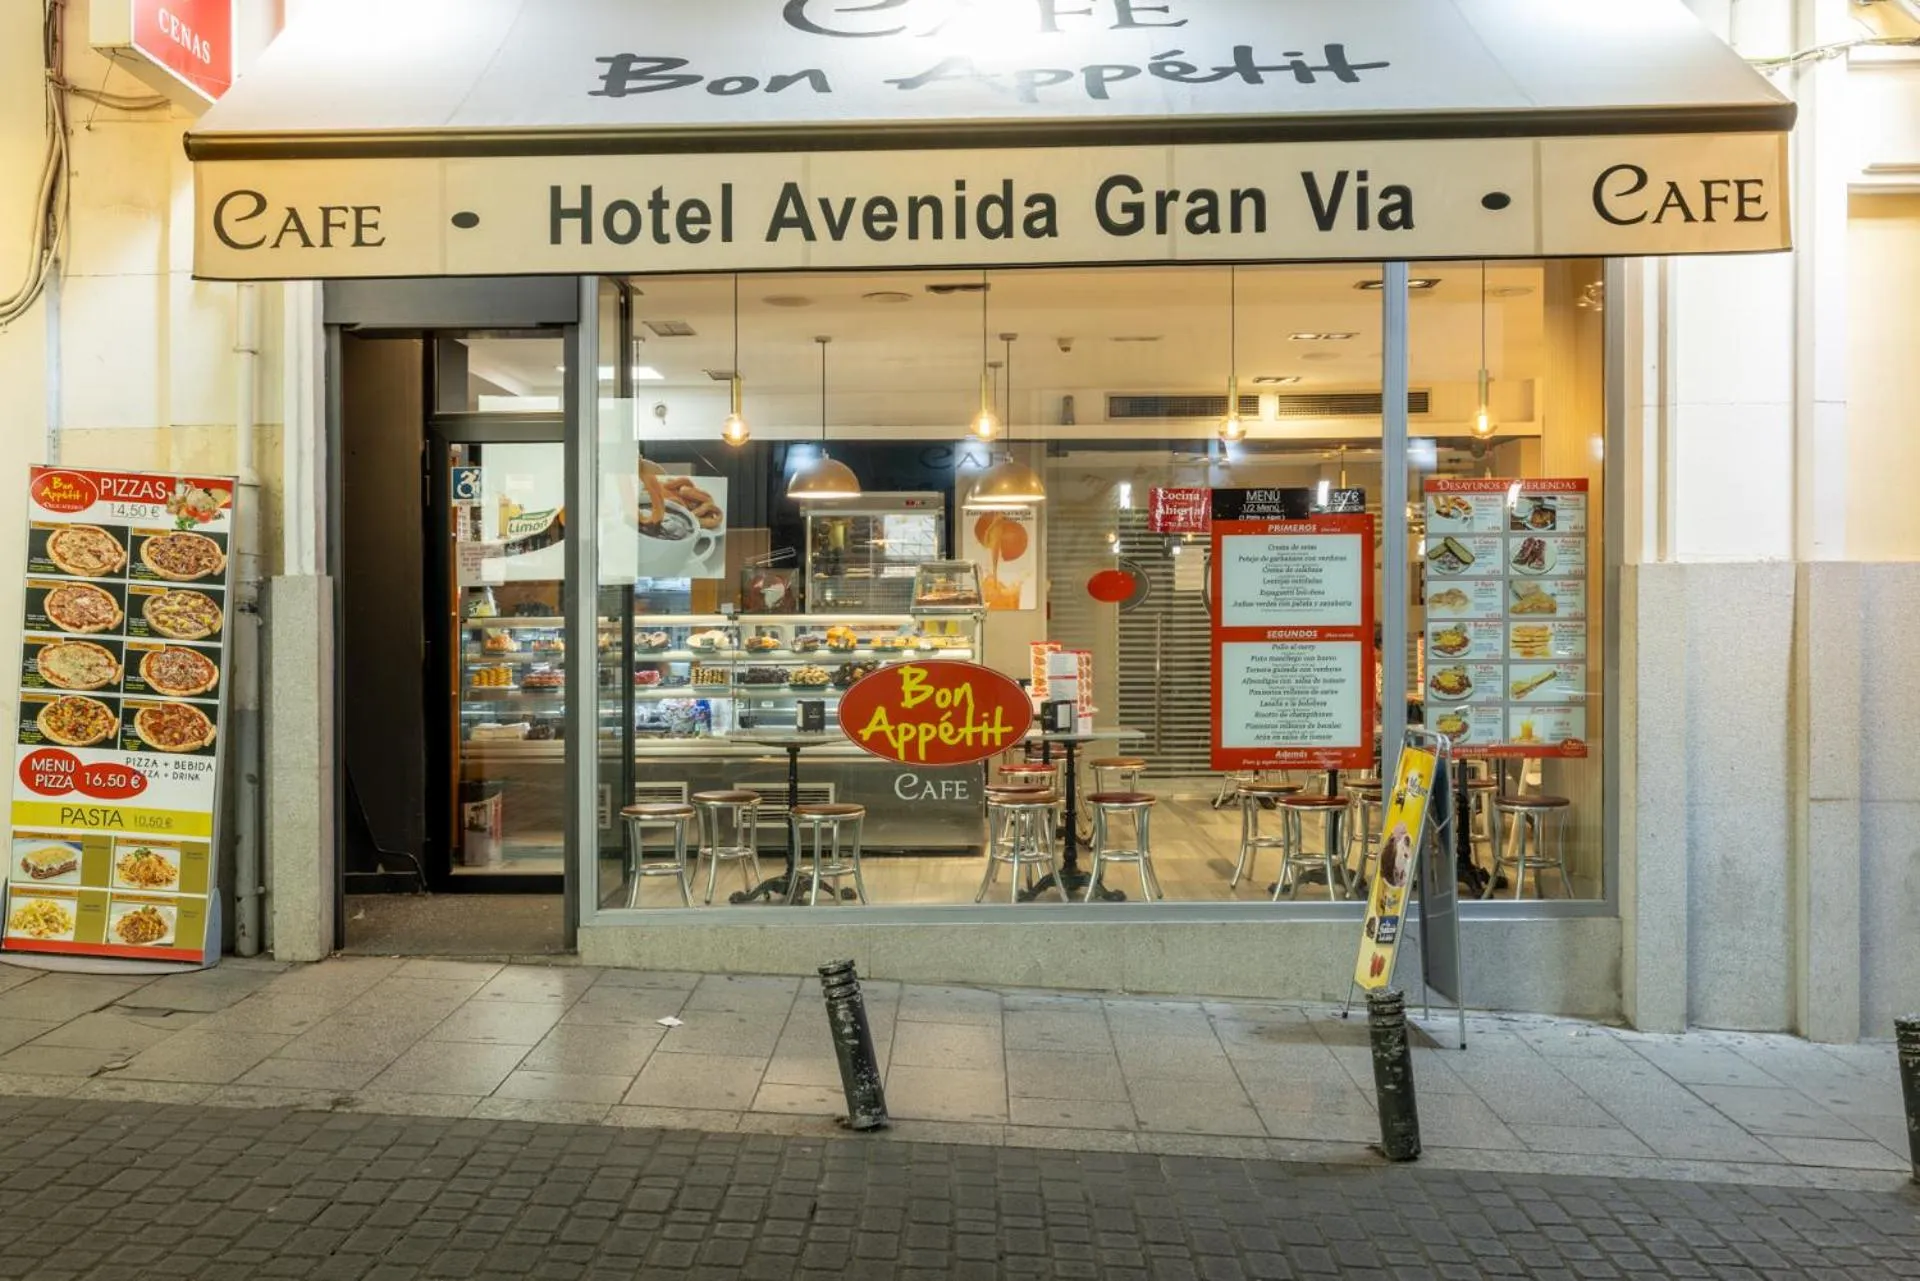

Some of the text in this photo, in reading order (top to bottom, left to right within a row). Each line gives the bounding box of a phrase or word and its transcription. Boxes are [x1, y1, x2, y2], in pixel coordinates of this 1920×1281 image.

[158, 9, 211, 65] CENAS
[587, 43, 1390, 102] Bon Appétit
[1592, 163, 1769, 226] CAFE
[550, 169, 1415, 246] Hotel Avenida Gran Via
[213, 190, 386, 250] CAFE
[100, 478, 166, 500] PIZZAS
[1246, 487, 1281, 502] MENÚ
[1438, 480, 1500, 491] DESAYUNOS
[111, 503, 147, 518] 14,50
[1267, 523, 1318, 534] PRIMEROS
[1266, 630, 1319, 639] SEGUNDOS
[898, 663, 975, 709] Bon
[859, 704, 1014, 761] Appétit
[31, 757, 75, 773] MENU
[126, 757, 159, 768] PIZZA
[174, 760, 214, 772] BEBIDA
[35, 774, 75, 790] PIZZA
[84, 772, 141, 789] 16,50 €
[172, 772, 201, 782] DRINK
[893, 773, 969, 801] CAFE
[60, 807, 124, 828] PASTA
